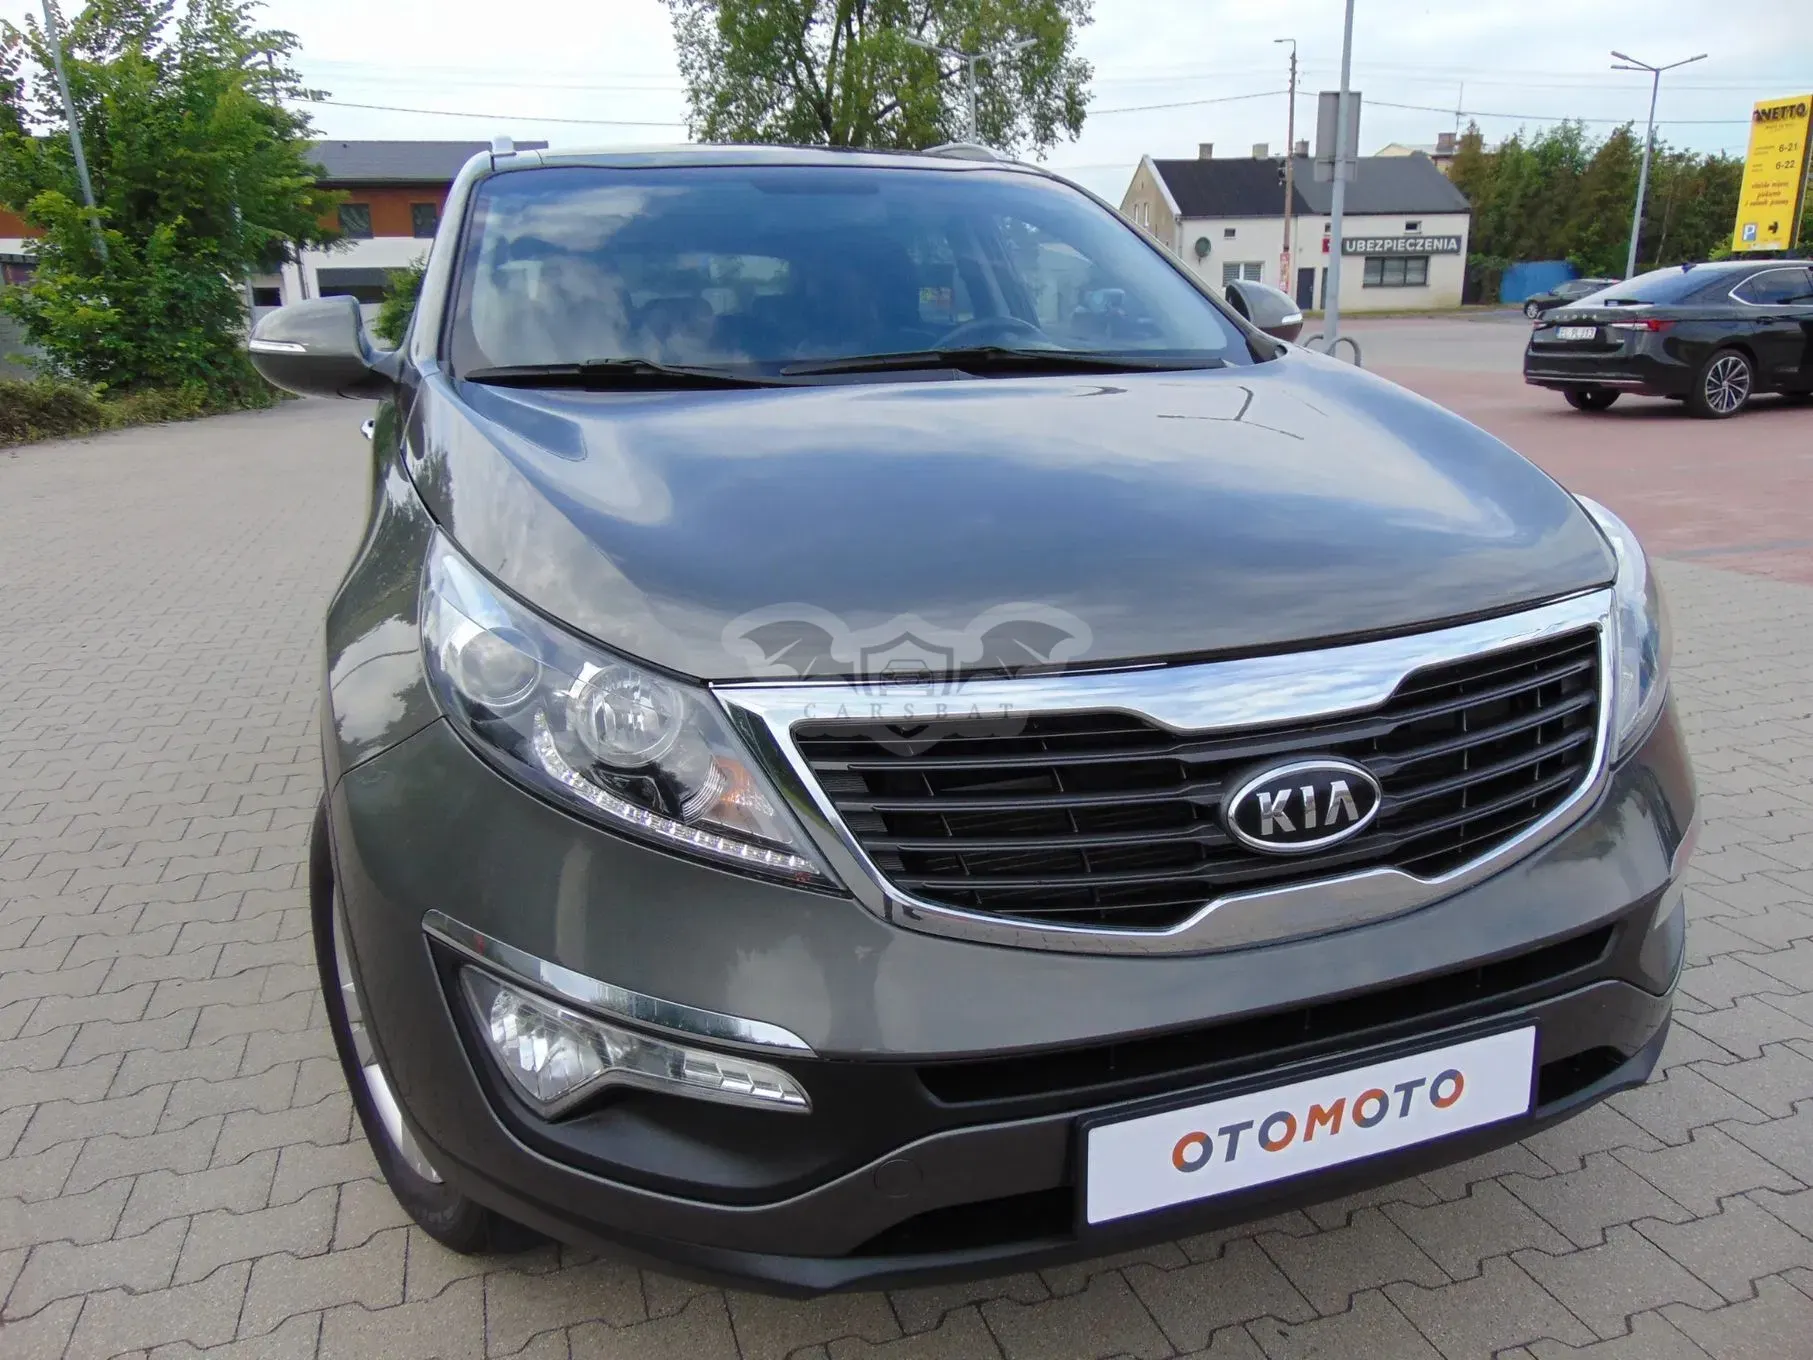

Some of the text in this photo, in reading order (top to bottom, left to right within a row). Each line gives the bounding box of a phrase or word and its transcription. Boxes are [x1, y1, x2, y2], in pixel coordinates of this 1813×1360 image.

[1761, 103, 1807, 121] NETTO
[1778, 142, 1798, 153] 6-21
[1775, 160, 1796, 170] 6-22
[1345, 237, 1458, 252] UBEZPIECZENIA
[1256, 779, 1360, 836] KIA
[1171, 1068, 1465, 1173] OTOMOTO
